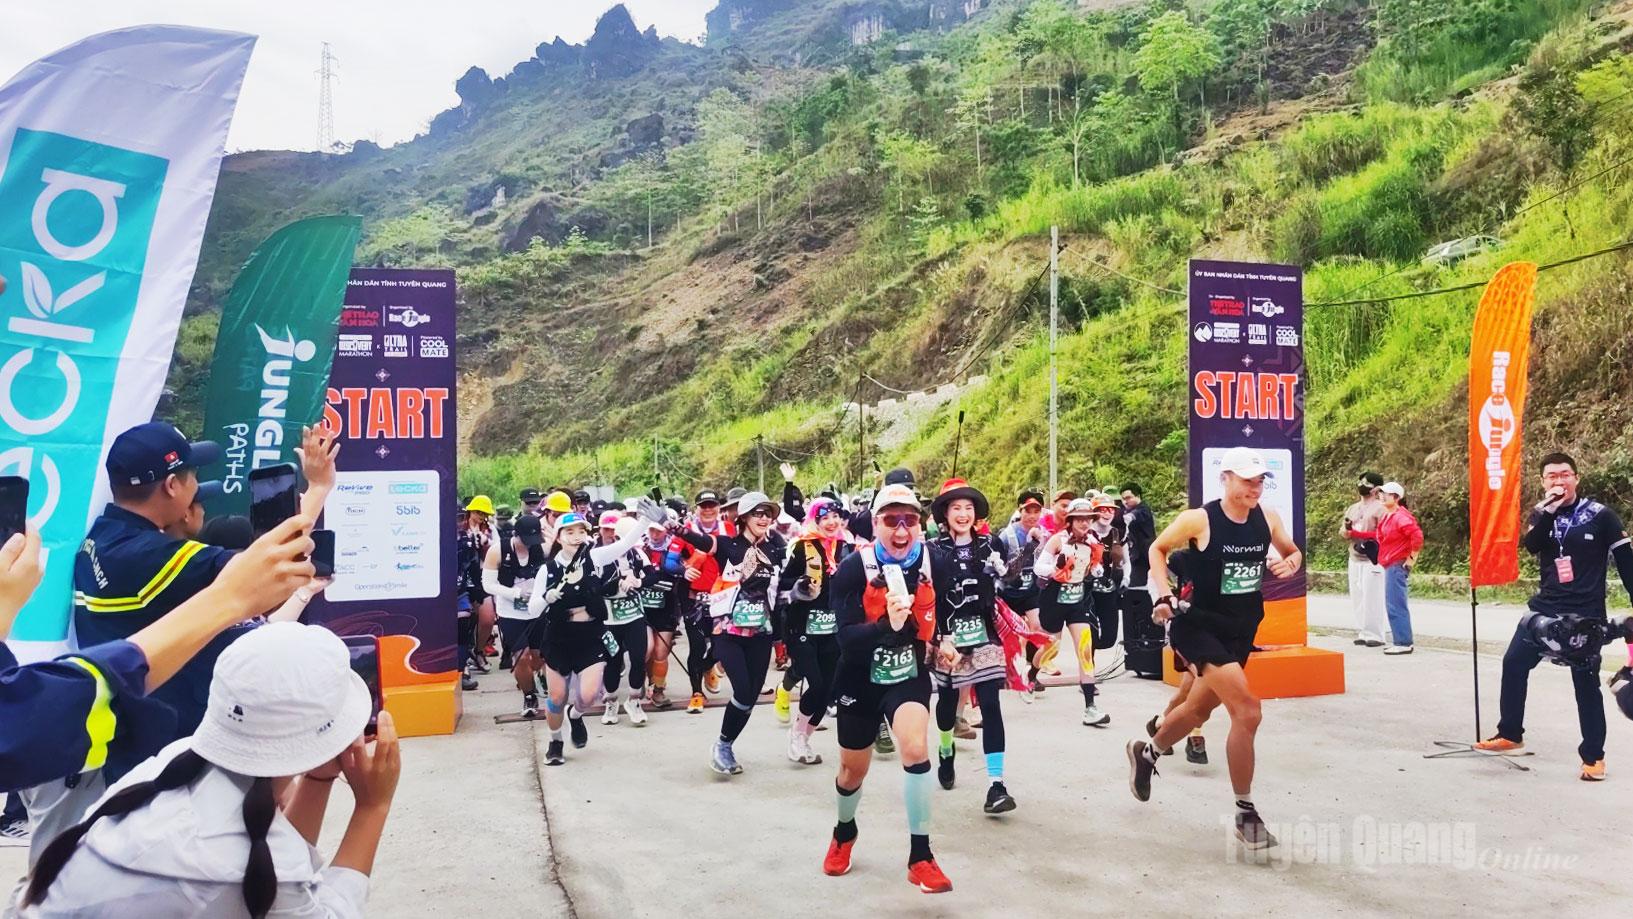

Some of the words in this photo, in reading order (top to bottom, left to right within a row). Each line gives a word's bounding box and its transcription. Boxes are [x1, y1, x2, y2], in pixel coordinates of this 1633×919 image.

[420, 340, 448, 348] COOL
[1275, 329, 1298, 337] COOL
[0, 166, 127, 575] ecka
[252, 322, 316, 470] JUNGL
[1194, 370, 1299, 420] START
[320, 387, 449, 439] START
[222, 423, 249, 494] PATHS
[1233, 564, 1261, 578] 2261
[956, 619, 982, 633] 2235
[882, 649, 913, 667] 2163
